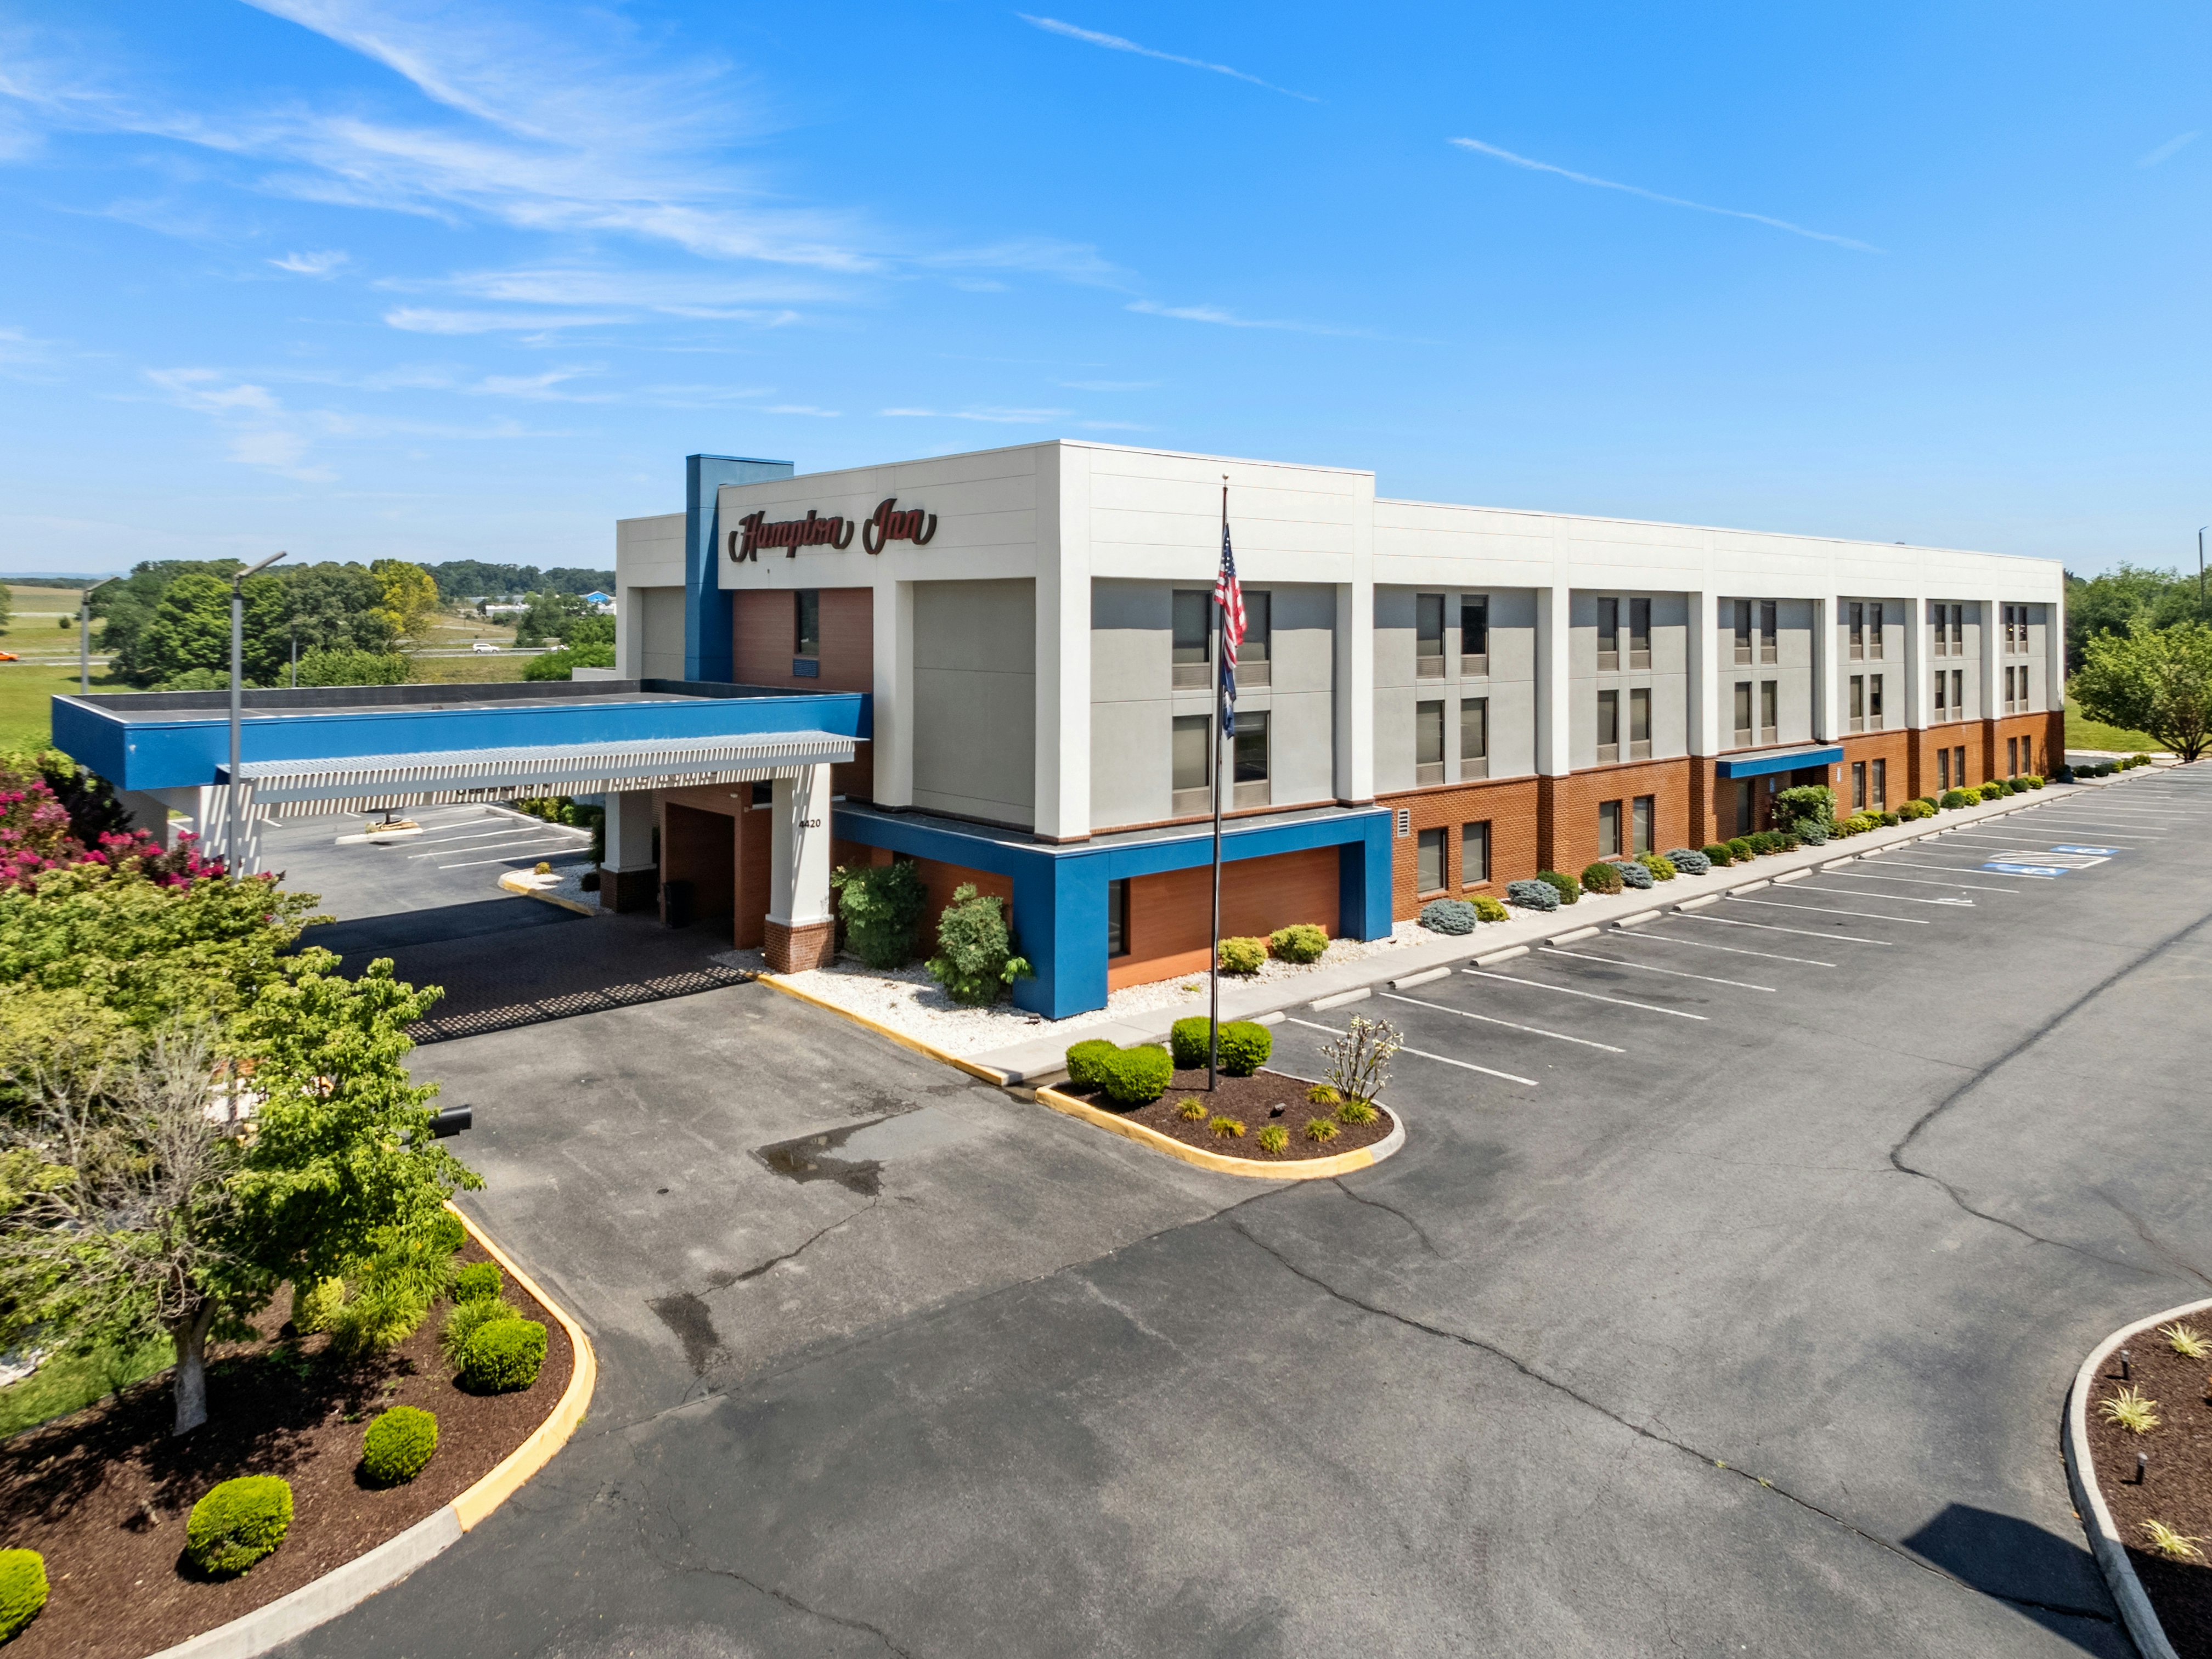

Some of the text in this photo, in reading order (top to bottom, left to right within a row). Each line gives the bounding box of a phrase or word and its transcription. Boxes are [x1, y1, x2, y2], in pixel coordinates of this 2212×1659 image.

[728, 498, 937, 562] Hampton Inn
[799, 819, 821, 828] 4420
